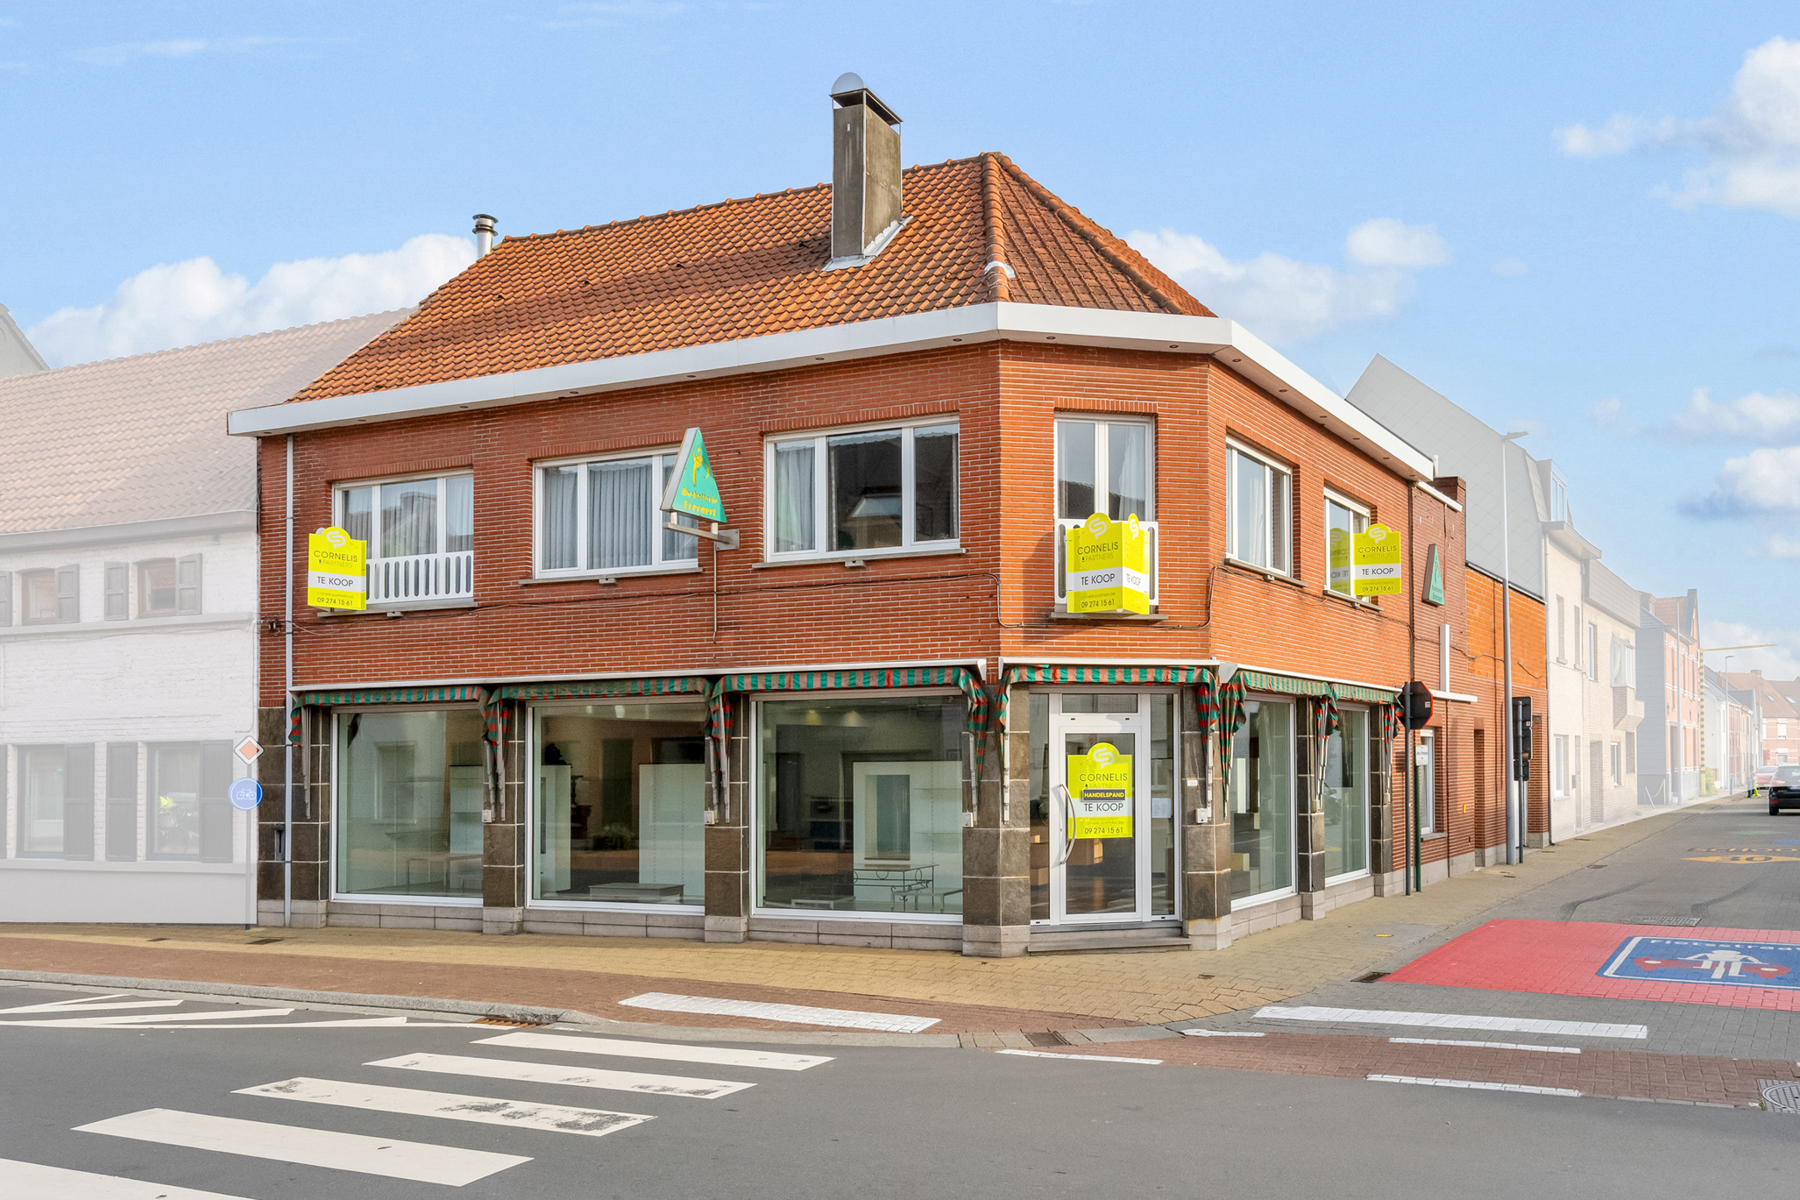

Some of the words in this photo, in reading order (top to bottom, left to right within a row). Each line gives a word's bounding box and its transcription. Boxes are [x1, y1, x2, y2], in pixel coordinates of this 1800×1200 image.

[1077, 541, 1119, 555] CORNELIS
[1358, 545, 1397, 554] CORNELIS
[313, 550, 358, 562] CORNELIS
[1086, 553, 1114, 562] PARTNERS
[322, 559, 353, 569] PARTNERS
[1362, 568, 1370, 576] TE
[1371, 567, 1394, 575] KOOP
[317, 576, 326, 584] TE
[329, 577, 354, 587] KOOP
[1081, 576, 1089, 586] TE
[1091, 573, 1116, 584] KOOP
[1089, 600, 1099, 608] 274
[1108, 598, 1115, 606] 61
[1079, 773, 1128, 782] CORNELIS
[1084, 803, 1093, 812] TE
[1096, 802, 1124, 812] KOOP
[1084, 827, 1092, 835] 09
[1094, 827, 1105, 835] 274
[1116, 826, 1123, 834] 61
